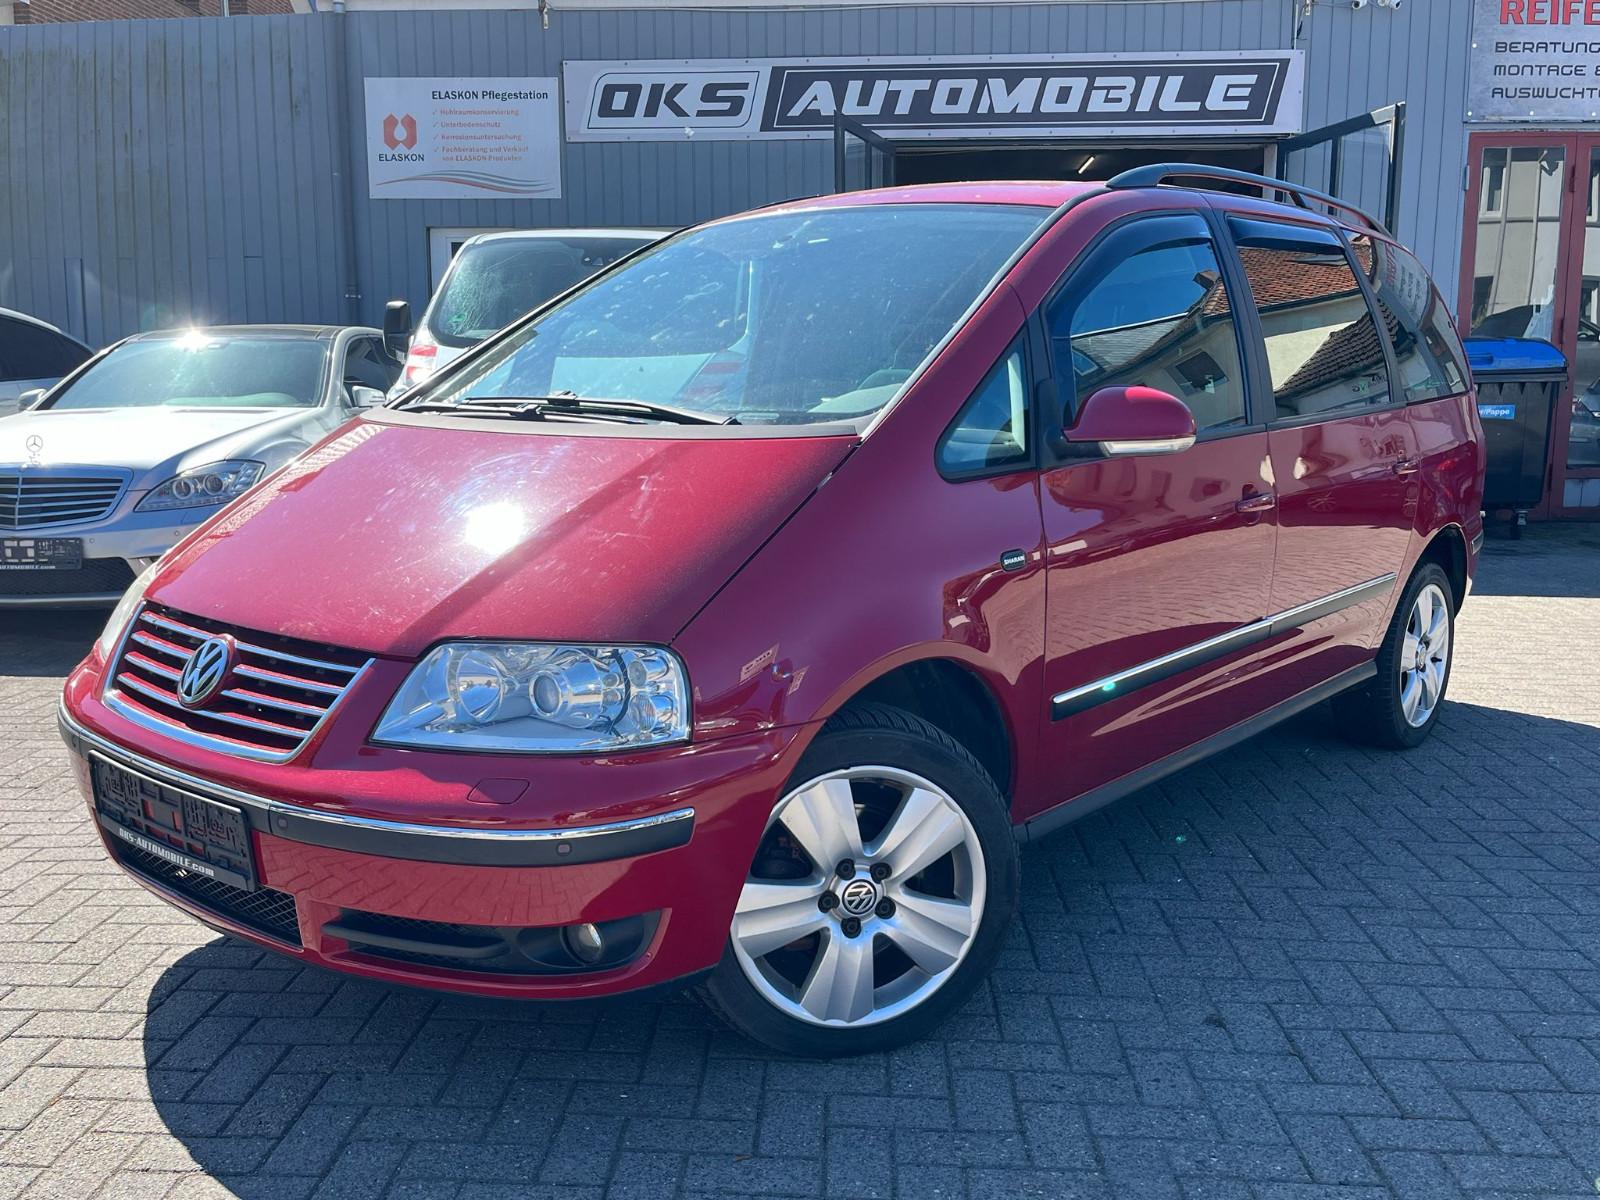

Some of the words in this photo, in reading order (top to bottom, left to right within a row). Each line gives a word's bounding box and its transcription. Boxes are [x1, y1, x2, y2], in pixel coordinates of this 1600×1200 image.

[1494, 42, 1600, 53] BERATUNG
[1493, 64, 1587, 76] MONTAGE
[431, 90, 479, 100] ELASKON
[481, 90, 549, 102] Pflegestation
[597, 82, 750, 118] OKS
[786, 74, 1258, 117] AUTOMOBILE
[1491, 87, 1600, 99] AUSWUCHT
[378, 153, 425, 162] ELASKON
